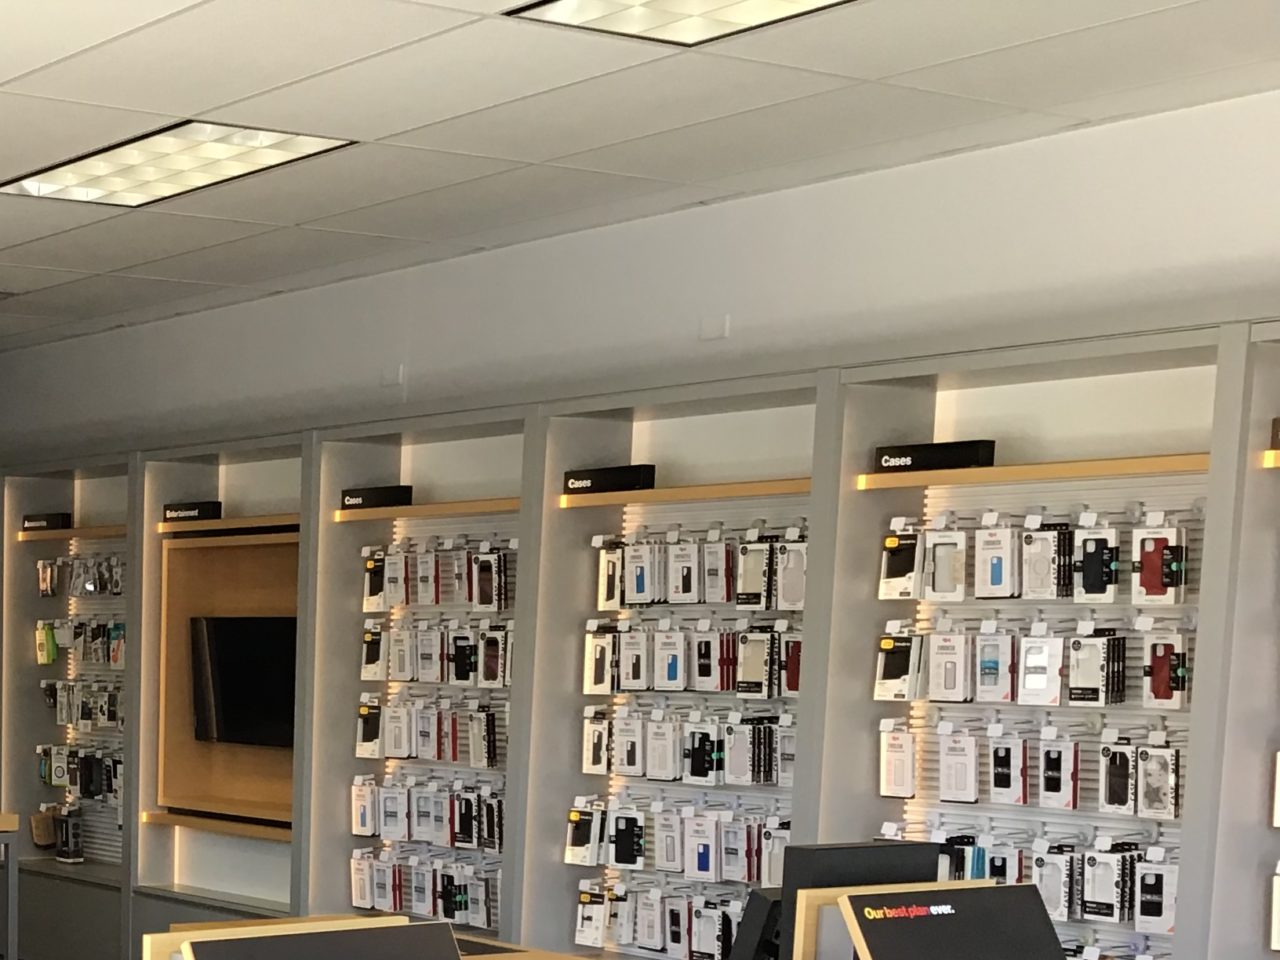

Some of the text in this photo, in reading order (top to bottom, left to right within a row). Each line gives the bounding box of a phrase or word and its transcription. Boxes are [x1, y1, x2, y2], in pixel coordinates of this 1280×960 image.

[881, 455, 912, 467] Cases
[568, 478, 591, 488] Cases
[344, 496, 363, 505] Cases
[864, 905, 955, 919] Our best plan ever.
